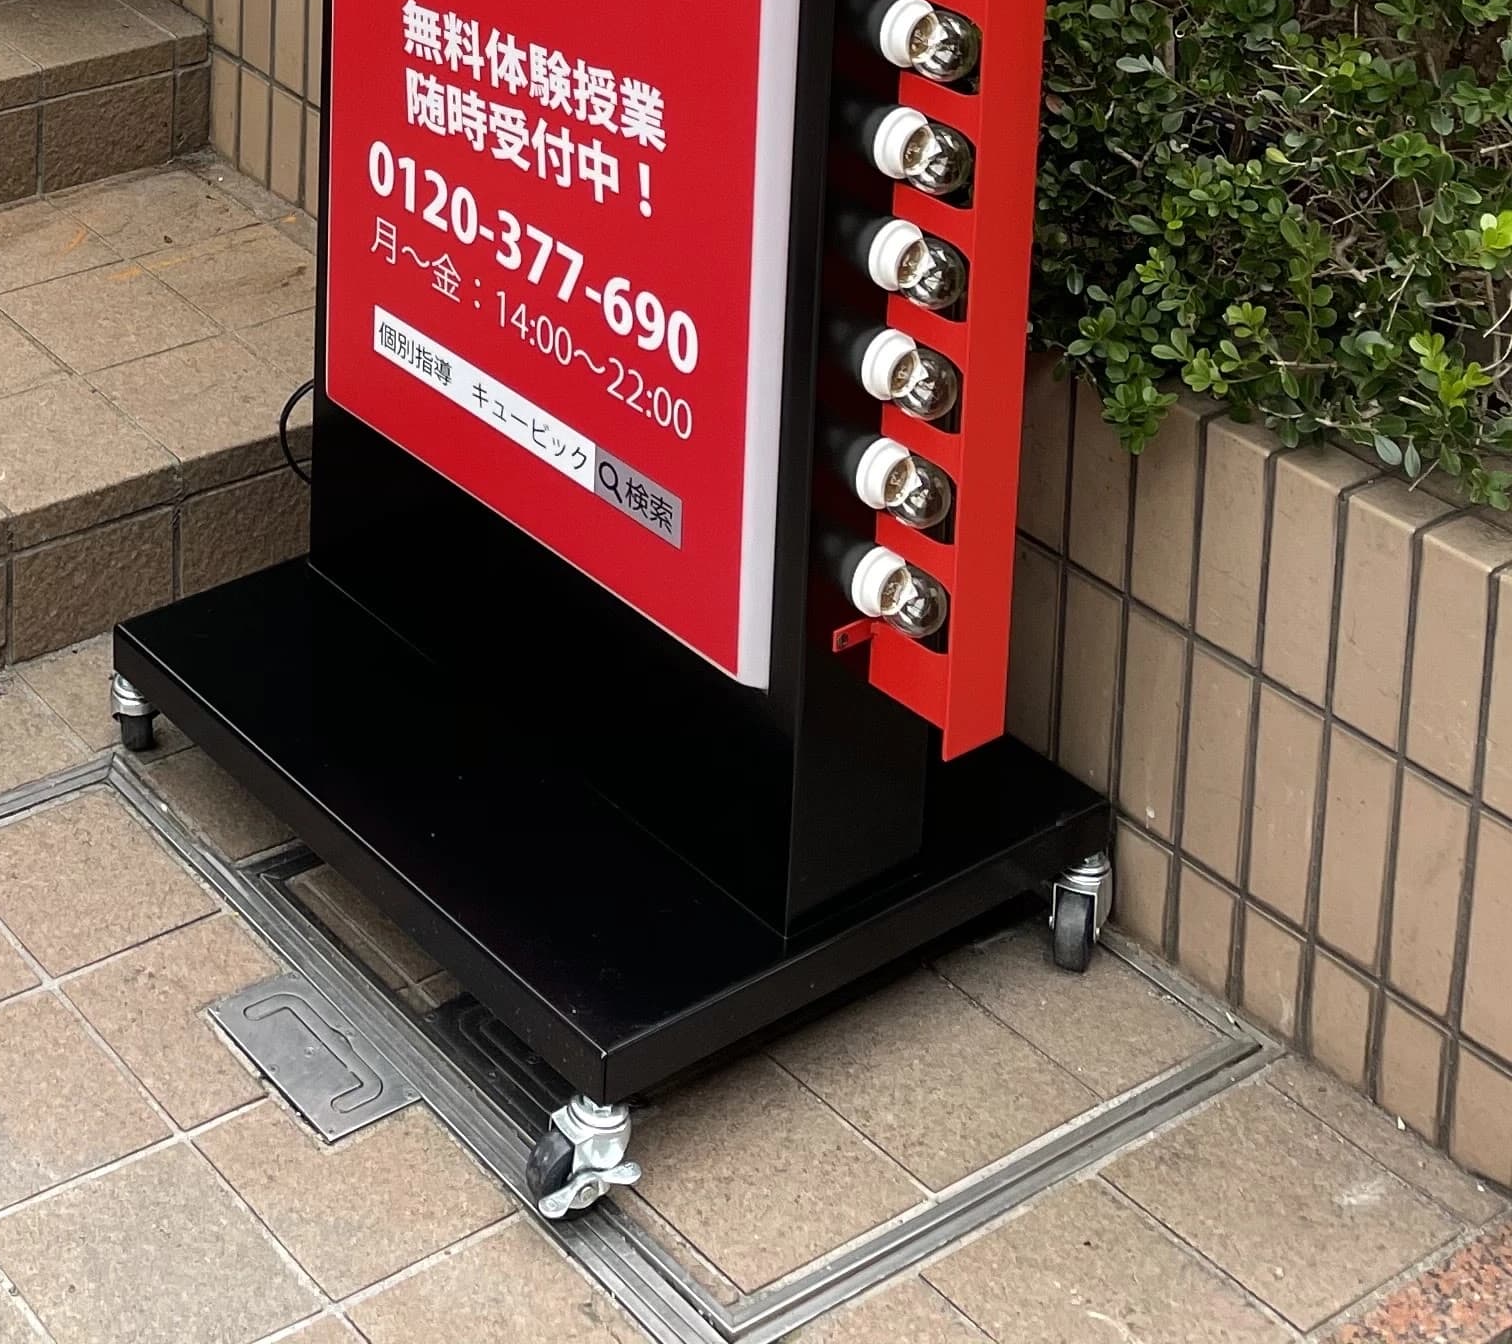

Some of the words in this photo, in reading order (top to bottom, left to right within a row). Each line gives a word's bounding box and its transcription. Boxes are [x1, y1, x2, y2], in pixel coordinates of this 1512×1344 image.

[405, 67, 653, 218] 随時受付中！
[368, 140, 699, 374] 0120-377-690
[624, 476, 674, 535] 検索
